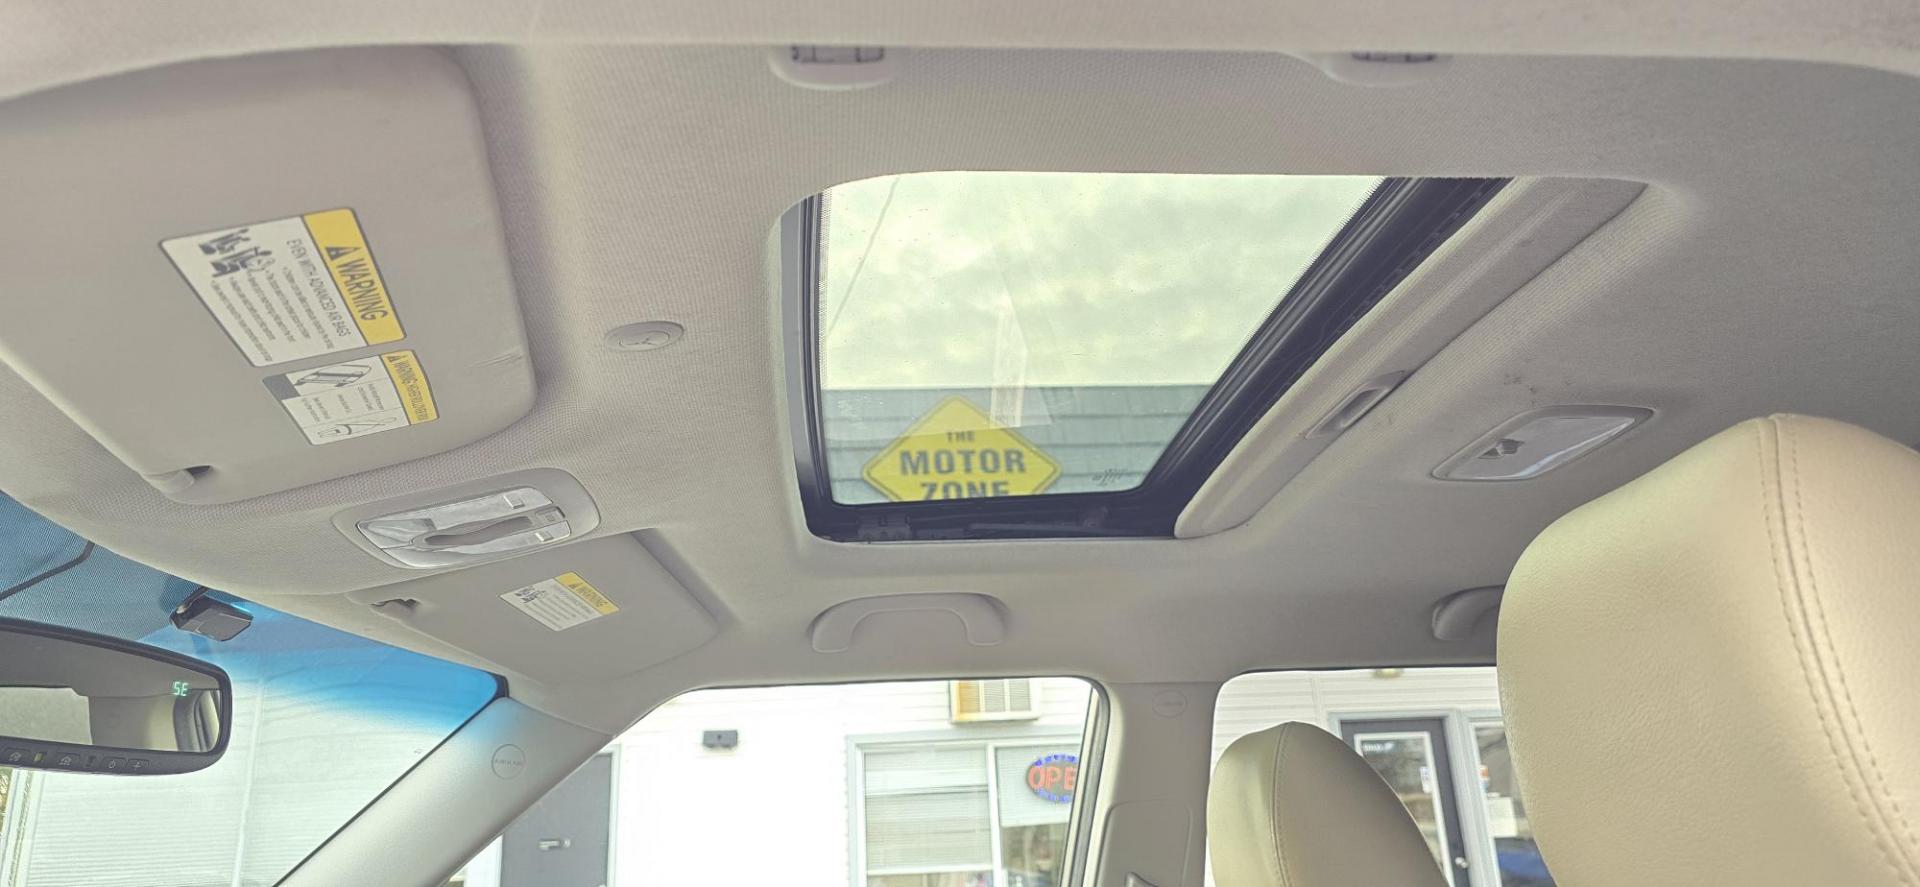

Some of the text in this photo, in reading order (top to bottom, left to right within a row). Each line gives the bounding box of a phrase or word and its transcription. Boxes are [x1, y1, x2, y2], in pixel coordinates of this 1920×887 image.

[285, 238, 308, 258] EVEN
[296, 258, 318, 277] WITH
[306, 276, 336, 311] ADVANCED
[334, 258, 389, 321] WARNING
[325, 310, 342, 321] AIR
[331, 320, 351, 336] BAGS
[946, 431, 975, 442] THE
[900, 449, 1026, 475] MOTOR
[921, 481, 1009, 500] ZONE
[173, 681, 189, 696] SE
[1028, 766, 1077, 790] OPE
